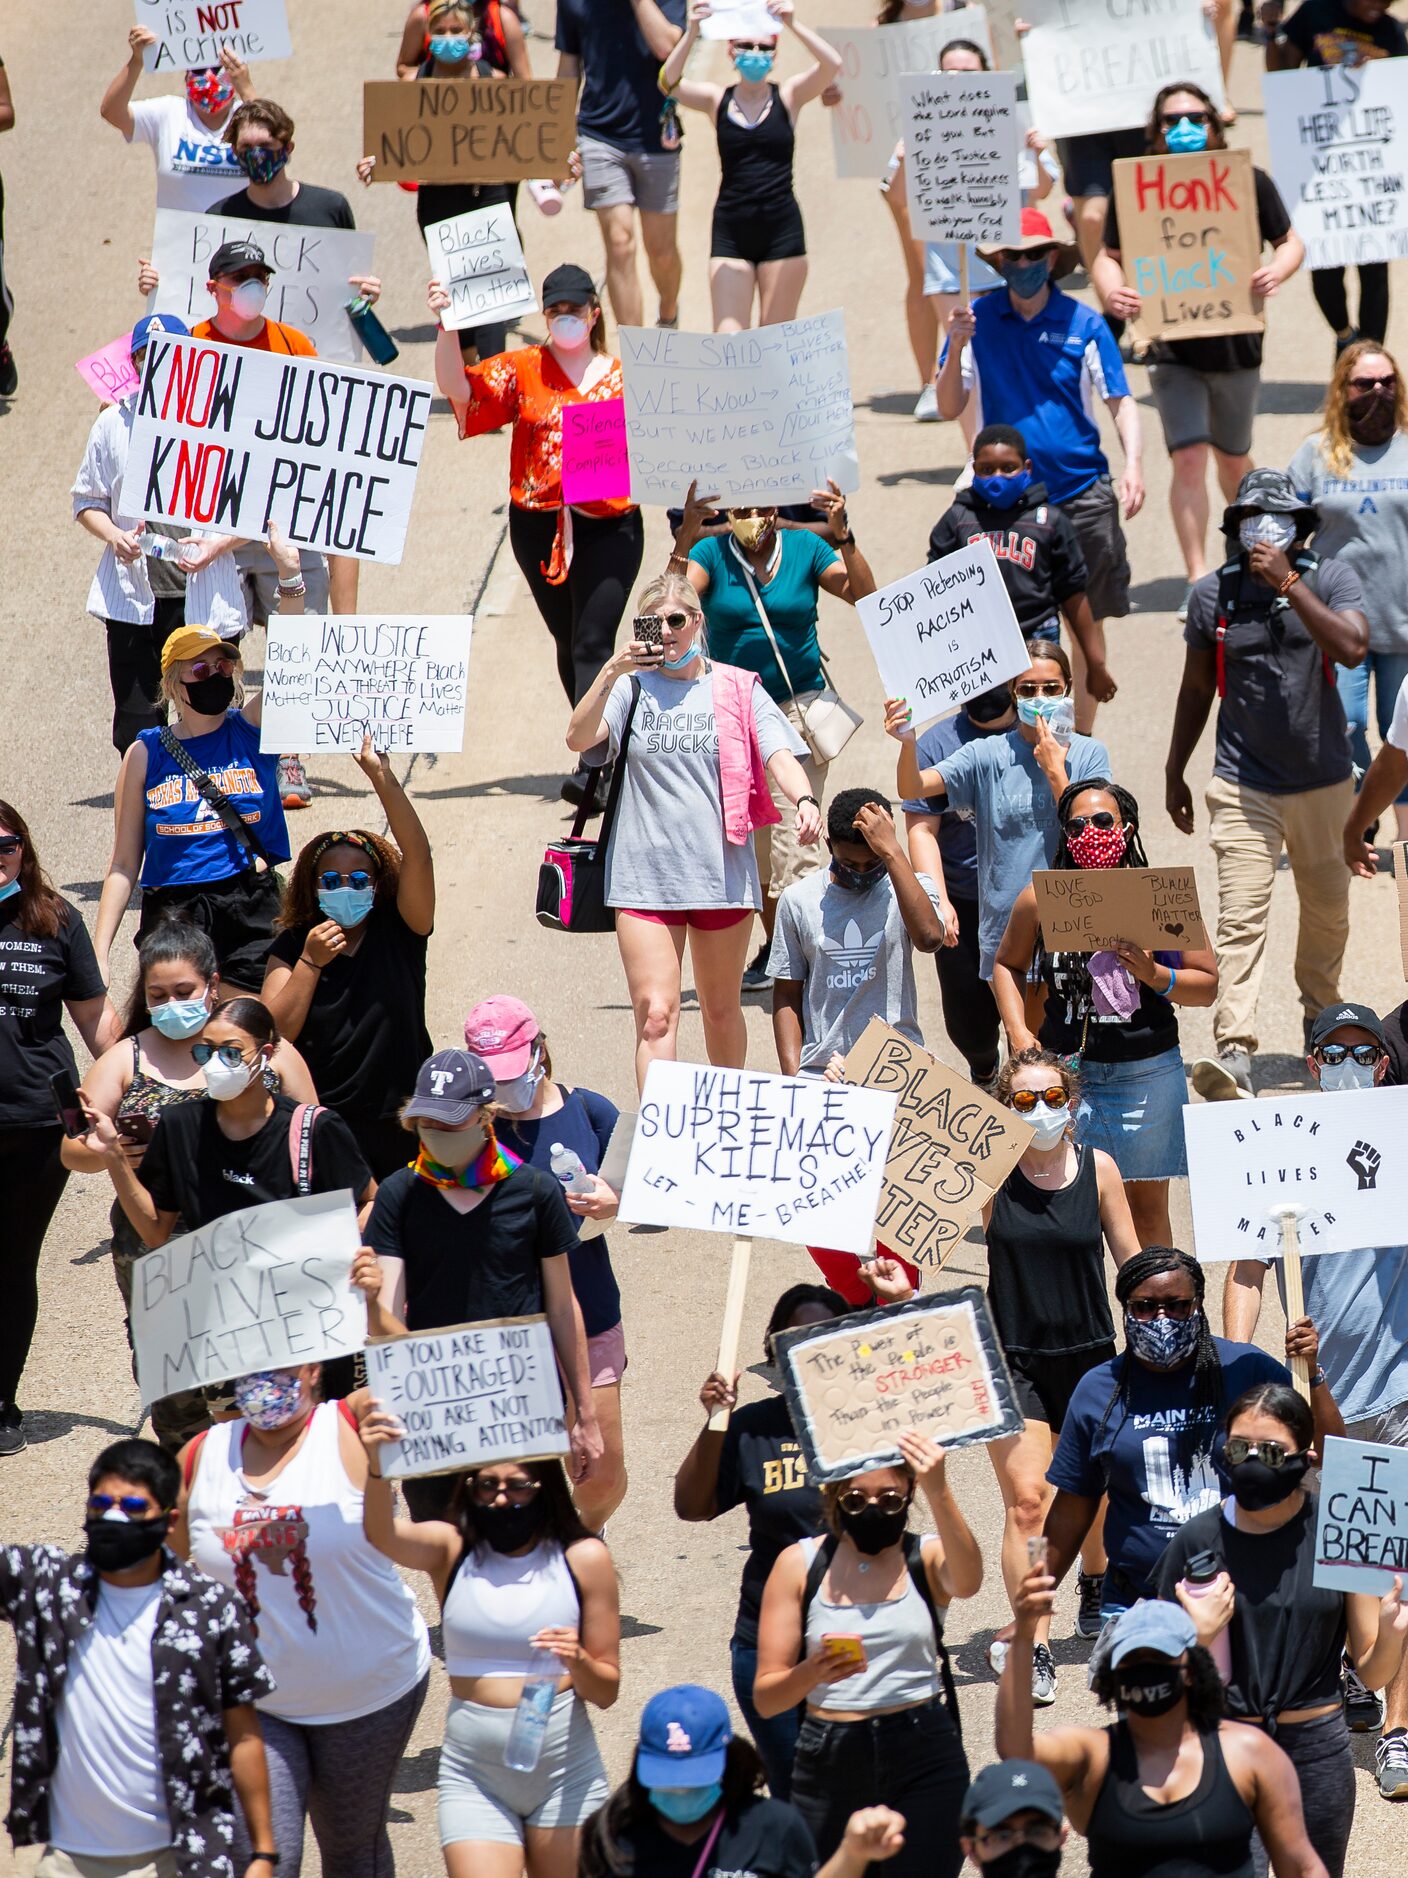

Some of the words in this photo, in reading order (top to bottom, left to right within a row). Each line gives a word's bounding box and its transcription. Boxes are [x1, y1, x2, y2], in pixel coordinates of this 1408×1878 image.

[166, 8, 186, 36] is
[197, 1, 244, 34] NOT
[154, 41, 176, 69] A
[419, 85, 459, 117] NO
[469, 83, 564, 115] JUSTICE
[1318, 65, 1360, 108] IS
[1299, 111, 1344, 144] HER
[382, 124, 433, 168] NO
[452, 122, 559, 166] PEACE
[1311, 150, 1384, 176] WORTH
[1134, 159, 1239, 213] Honk
[1301, 178, 1352, 202] LESS
[1322, 200, 1397, 231] MINE?
[439, 219, 505, 252] Black
[1160, 216, 1221, 248] for
[447, 249, 504, 280] Lives
[1133, 247, 1238, 295] Black
[451, 268, 532, 315] Matter!
[1160, 298, 1233, 323] Lives
[623, 328, 678, 363] WE
[701, 339, 761, 367] SAID
[139, 340, 243, 432] KNOW
[255, 365, 431, 467] JUSTICE
[629, 379, 681, 412] WE
[697, 384, 756, 412] KNOW
[688, 429, 715, 443] WE
[722, 420, 774, 440] NEED
[741, 450, 801, 471] Black
[144, 436, 250, 528] KNOW
[262, 458, 389, 556] PEACE
[879, 591, 914, 626] STOP
[916, 598, 974, 643] RACISM
[268, 642, 311, 663] Black
[321, 622, 430, 659] INJUSTICE
[949, 640, 959, 652] IS
[267, 668, 313, 685] Women
[314, 659, 417, 681] ANYWHERE
[427, 661, 465, 680] Black
[916, 648, 998, 698] PATRIOTISM
[264, 692, 312, 707] Matter
[315, 676, 332, 696] IS
[335, 680, 348, 694] A
[350, 678, 398, 693] THREAT
[401, 681, 416, 694] TO
[420, 682, 462, 700] Lives
[311, 695, 413, 721] JUSTICE
[419, 702, 464, 716] Matter
[147, 779, 182, 810] TEXAS
[1045, 878, 1087, 898] LOVE
[1069, 892, 1103, 908] GOD
[1154, 893, 1194, 906] LIVES
[1052, 916, 1093, 932] LOVE
[1152, 909, 1202, 922] MATTER
[11, 962, 45, 974] THEM.
[827, 967, 876, 988] adidas
[2, 983, 39, 995] THEM.
[694, 1072, 849, 1120] WHITE
[862, 1039, 1005, 1160] BLACK
[641, 1103, 884, 1162] SUPREMACY
[1234, 1114, 1320, 1142] BLACK
[222, 1169, 254, 1185] black
[643, 1167, 677, 1193] LET
[694, 1141, 820, 1190] KILLS
[1247, 1167, 1317, 1185] LIVES
[141, 1215, 281, 1311] BLACK
[183, 1257, 336, 1340] LIVES
[163, 1307, 346, 1395] MATTER
[376, 1346, 393, 1372] IF
[406, 1339, 443, 1367] YOU
[452, 1333, 485, 1358] ARE
[500, 1329, 531, 1350] NOT
[405, 1353, 526, 1401] OUTRAGED
[876, 1352, 972, 1393] STRONGER
[400, 1410, 432, 1432] YOU
[445, 1403, 477, 1426] ARE
[490, 1395, 529, 1421] NOT
[401, 1431, 465, 1467] PAYING
[479, 1415, 566, 1448] ATTENTION
[1358, 1456, 1389, 1494] I
[1120, 1682, 1171, 1703] LOVE
